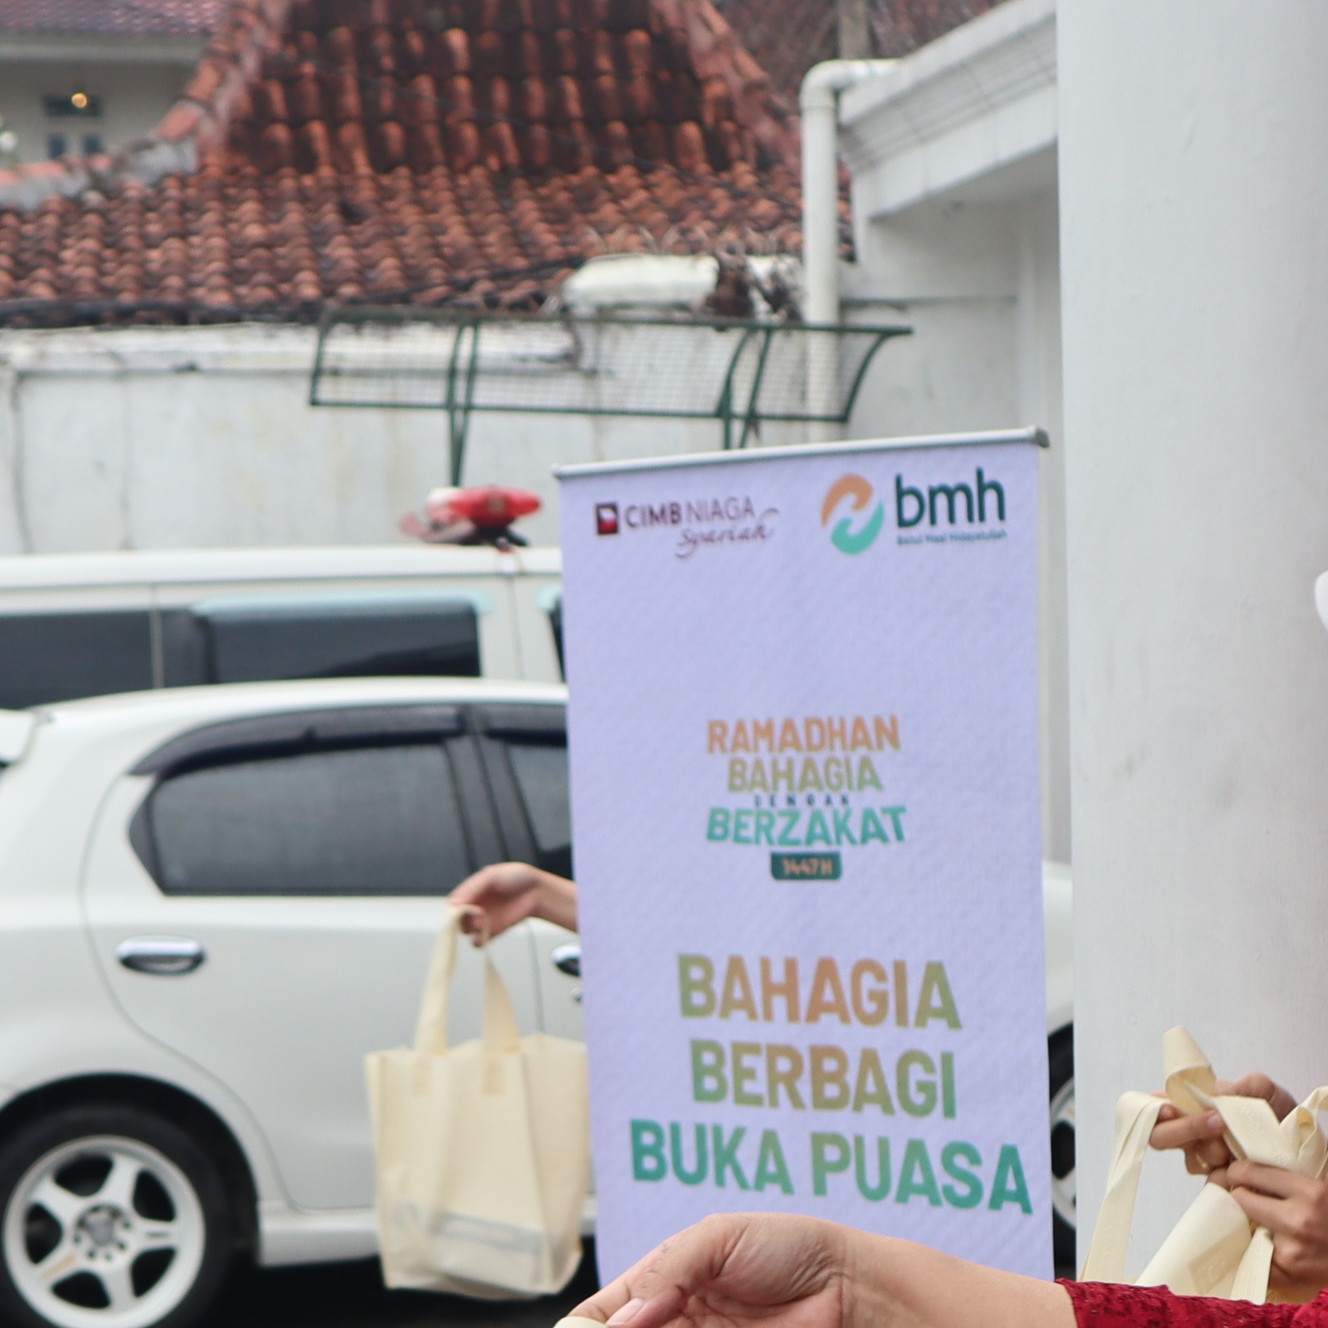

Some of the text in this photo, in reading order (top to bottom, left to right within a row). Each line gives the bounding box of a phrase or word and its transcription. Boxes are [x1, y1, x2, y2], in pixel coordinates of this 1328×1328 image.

[625, 467, 1007, 529] CIMB NIAGA bmh
[707, 714, 902, 755] RAMADHAN
[727, 755, 884, 794] BAHAGIA
[706, 805, 908, 847] BERZAKAT
[676, 952, 964, 1031] BAHAGIA
[688, 1038, 957, 1120] BERBAGI
[628, 1118, 1035, 1216] BUKA PUASA
